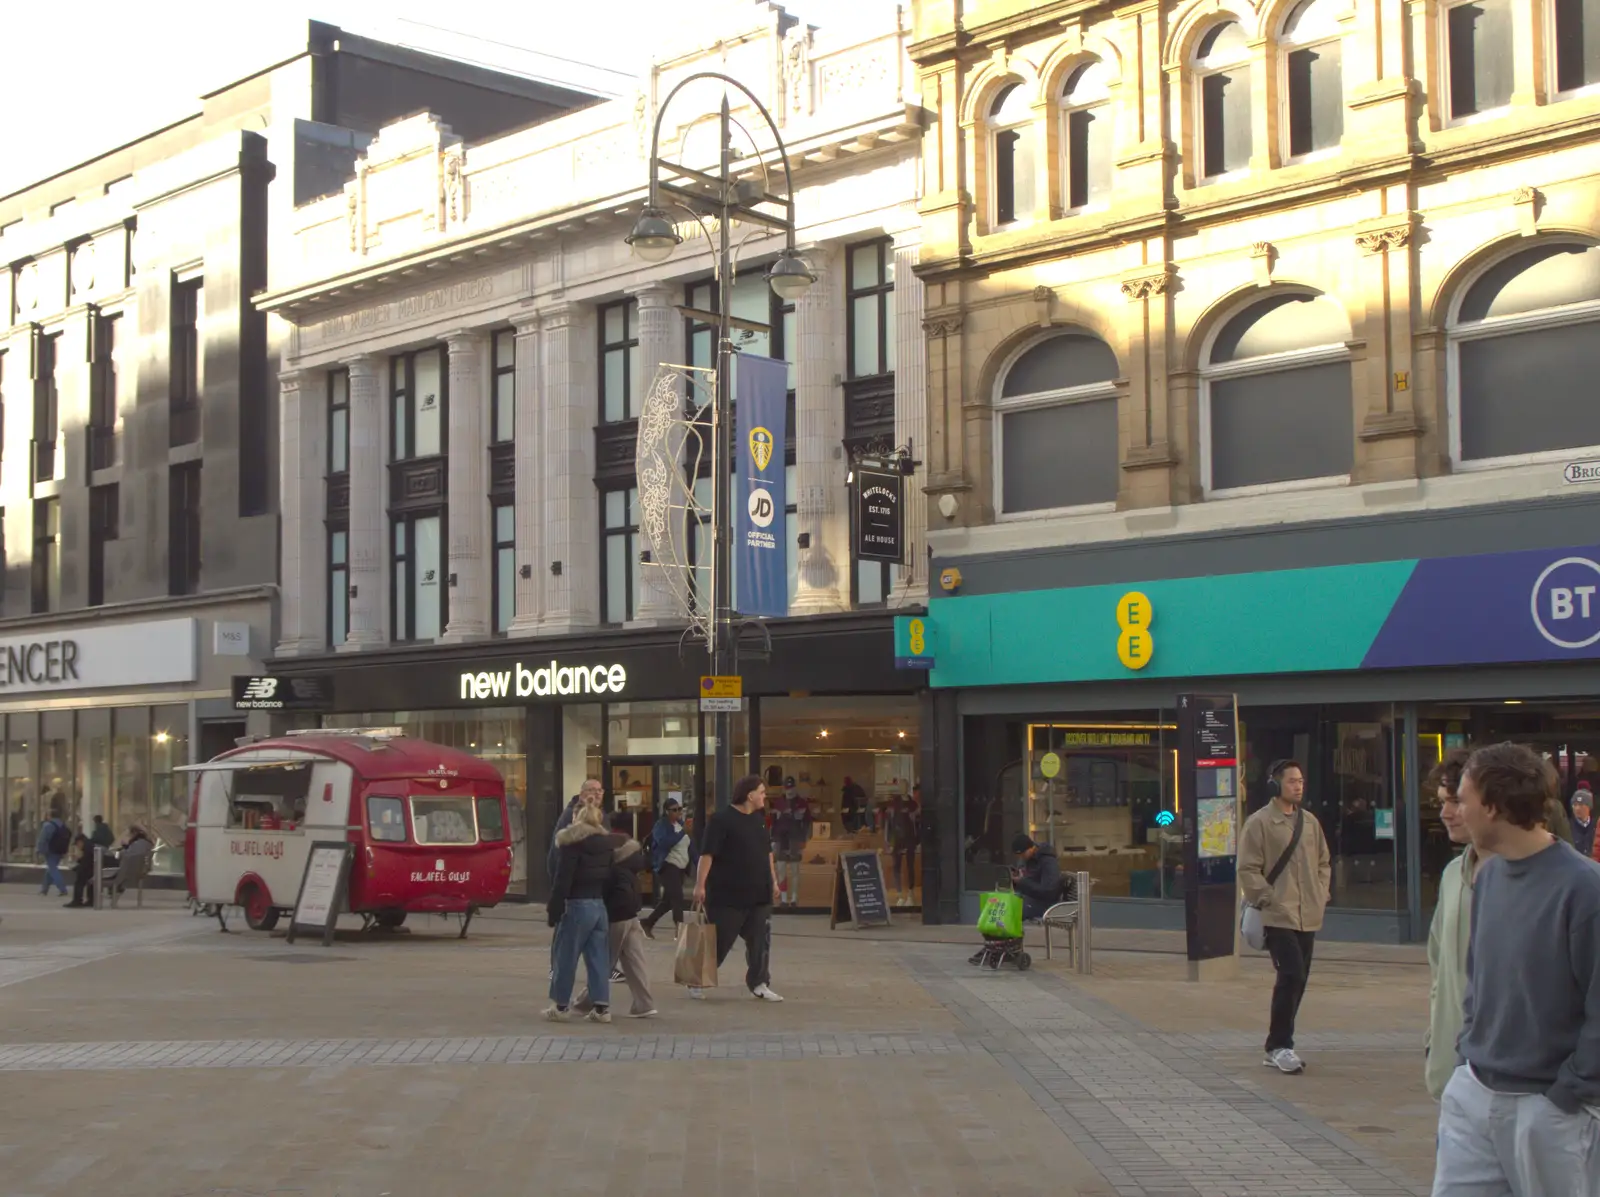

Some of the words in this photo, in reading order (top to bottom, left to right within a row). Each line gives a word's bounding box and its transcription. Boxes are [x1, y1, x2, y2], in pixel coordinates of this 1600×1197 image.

[751, 497, 771, 517] JD
[747, 531, 775, 541] OFFICIAL
[864, 534, 875, 542] ALE
[876, 536, 895, 545] HOUSE
[747, 539, 776, 549] PARTNER
[1551, 586, 1596, 619] BT
[222, 632, 242, 641] M&S
[460, 671, 511, 699] new
[515, 660, 627, 697] balance
[252, 700, 283, 708] balance
[411, 872, 446, 882] FALAFEL
[448, 872, 471, 883] GUYS
